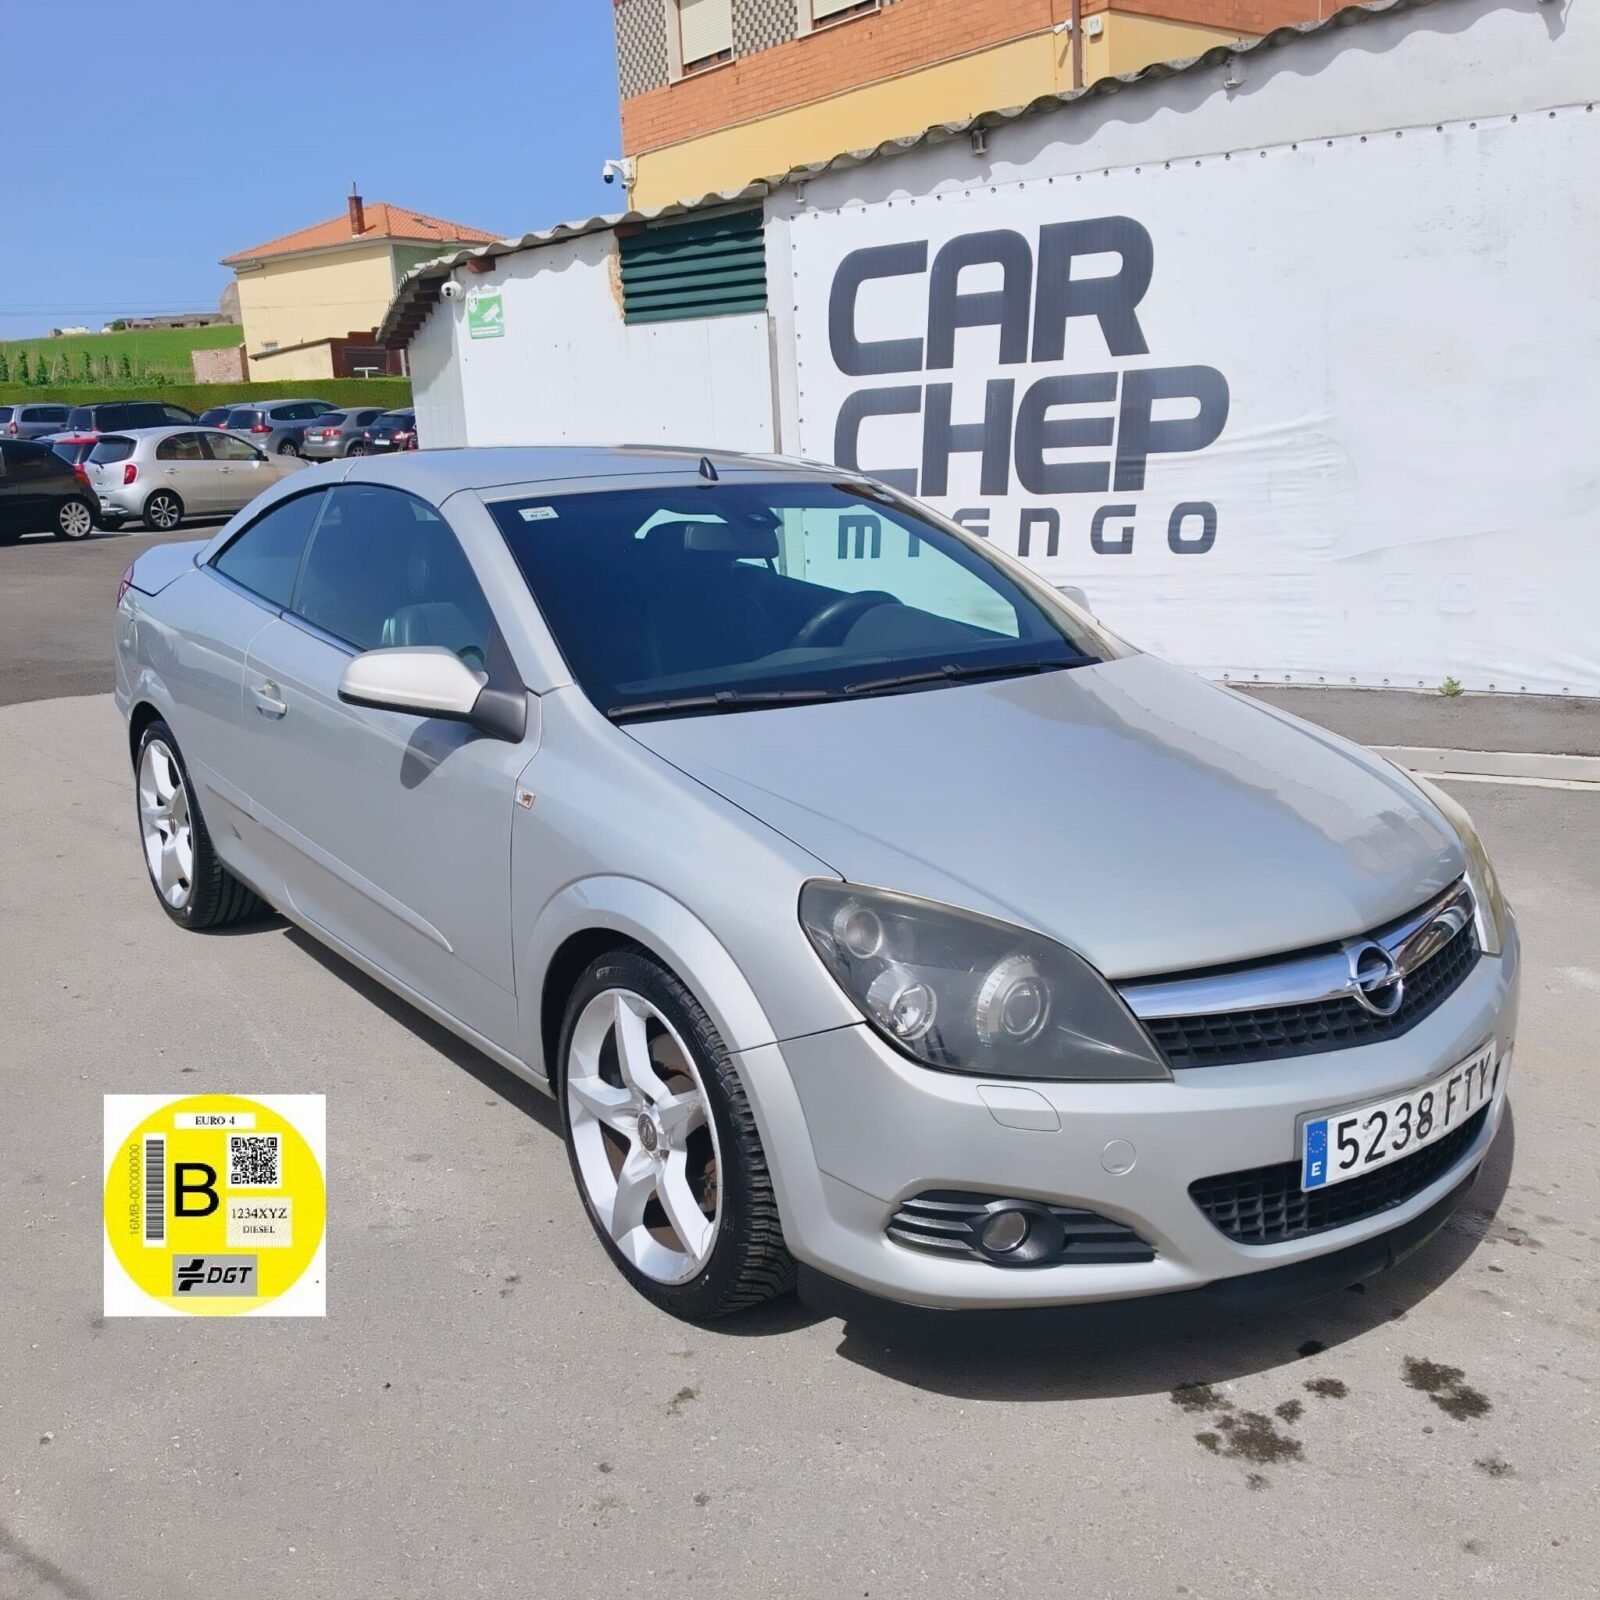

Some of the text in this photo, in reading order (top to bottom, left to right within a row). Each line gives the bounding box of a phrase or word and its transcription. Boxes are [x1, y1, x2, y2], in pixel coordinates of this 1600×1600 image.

[829, 215, 1154, 376] CAR
[834, 365, 1230, 496] CHEP
[1311, 1050, 1493, 1177] E 5238 FTY
